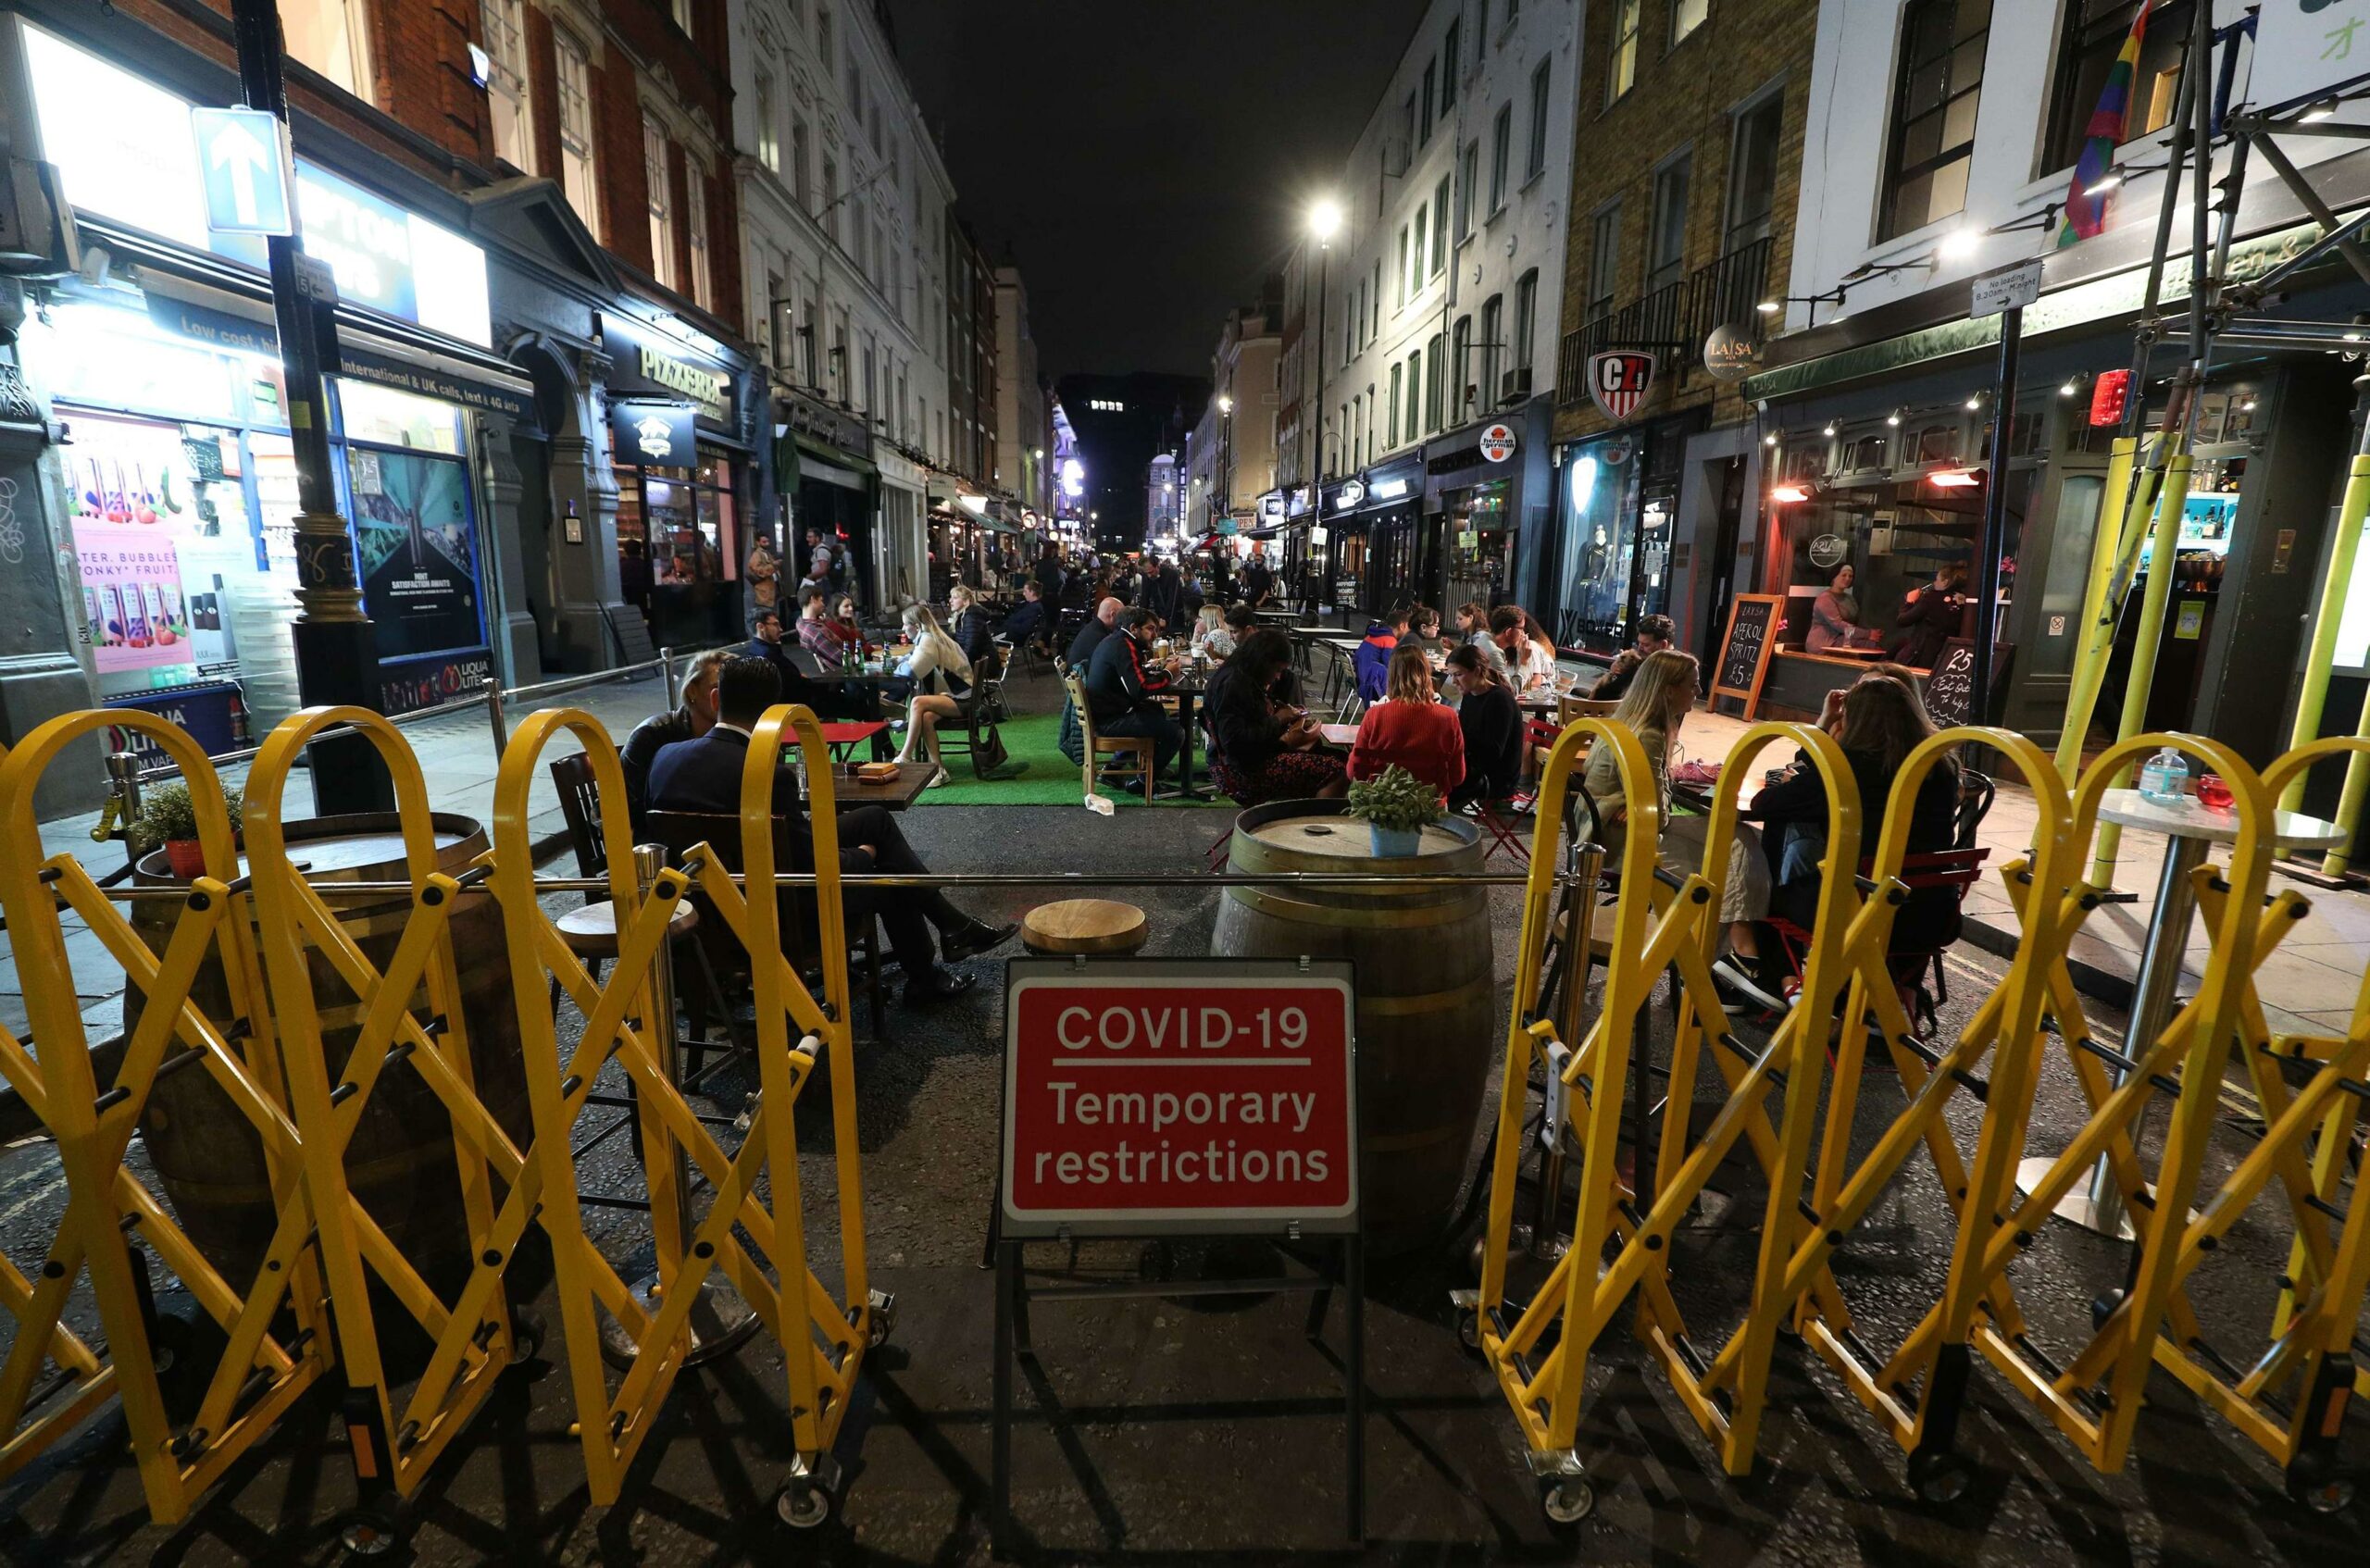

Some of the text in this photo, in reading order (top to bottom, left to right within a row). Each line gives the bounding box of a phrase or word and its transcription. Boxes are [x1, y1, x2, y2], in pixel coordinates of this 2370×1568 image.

[299, 277, 309, 292] 5
[1990, 274, 2026, 289] No loading
[181, 315, 215, 341] Low
[341, 358, 408, 387] International
[411, 375, 420, 389] &
[421, 378, 437, 392] UK
[439, 384, 463, 402] calls,
[464, 390, 481, 404] text
[640, 344, 719, 404] PIZZERIA
[119, 553, 177, 563] BUBBLES
[80, 565, 177, 577] ONKY FRUIT.
[392, 579, 430, 590] SATISFACTION
[1732, 622, 1764, 641] APEROL
[1728, 641, 1758, 663] SPRITZ
[461, 660, 489, 676] LIQUA
[1728, 664, 1745, 686] £5
[1937, 678, 1955, 691] Eat
[150, 754, 175, 769] VAP
[1057, 1006, 1308, 1050] COVID-19
[1047, 1082, 1316, 1133] Temporary
[1034, 1139, 1328, 1184] restrictions
